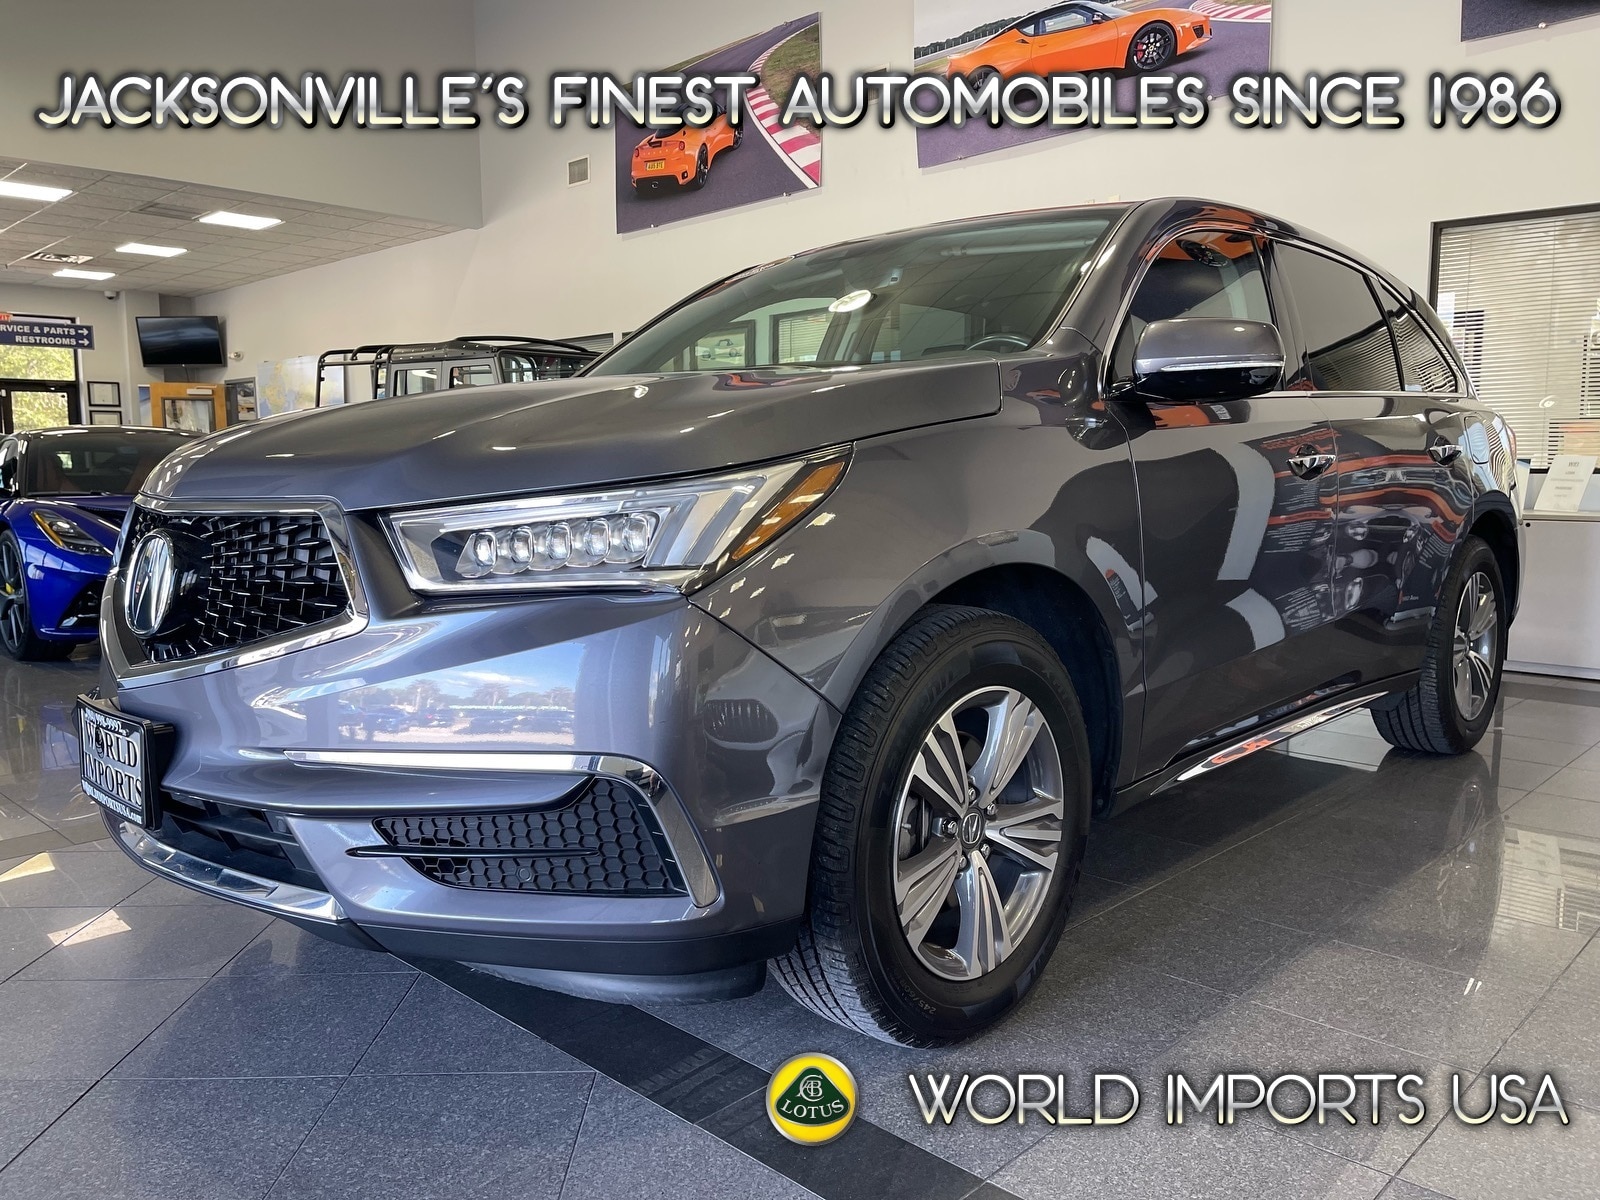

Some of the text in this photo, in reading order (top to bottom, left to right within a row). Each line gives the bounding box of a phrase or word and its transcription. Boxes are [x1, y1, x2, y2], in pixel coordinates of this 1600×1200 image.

[15, 335, 77, 345] RESTROOMS
[33, 325, 41, 334] &
[43, 326, 76, 335] PARTS
[86, 721, 139, 768] WORLD
[83, 752, 142, 806] IMPORTS
